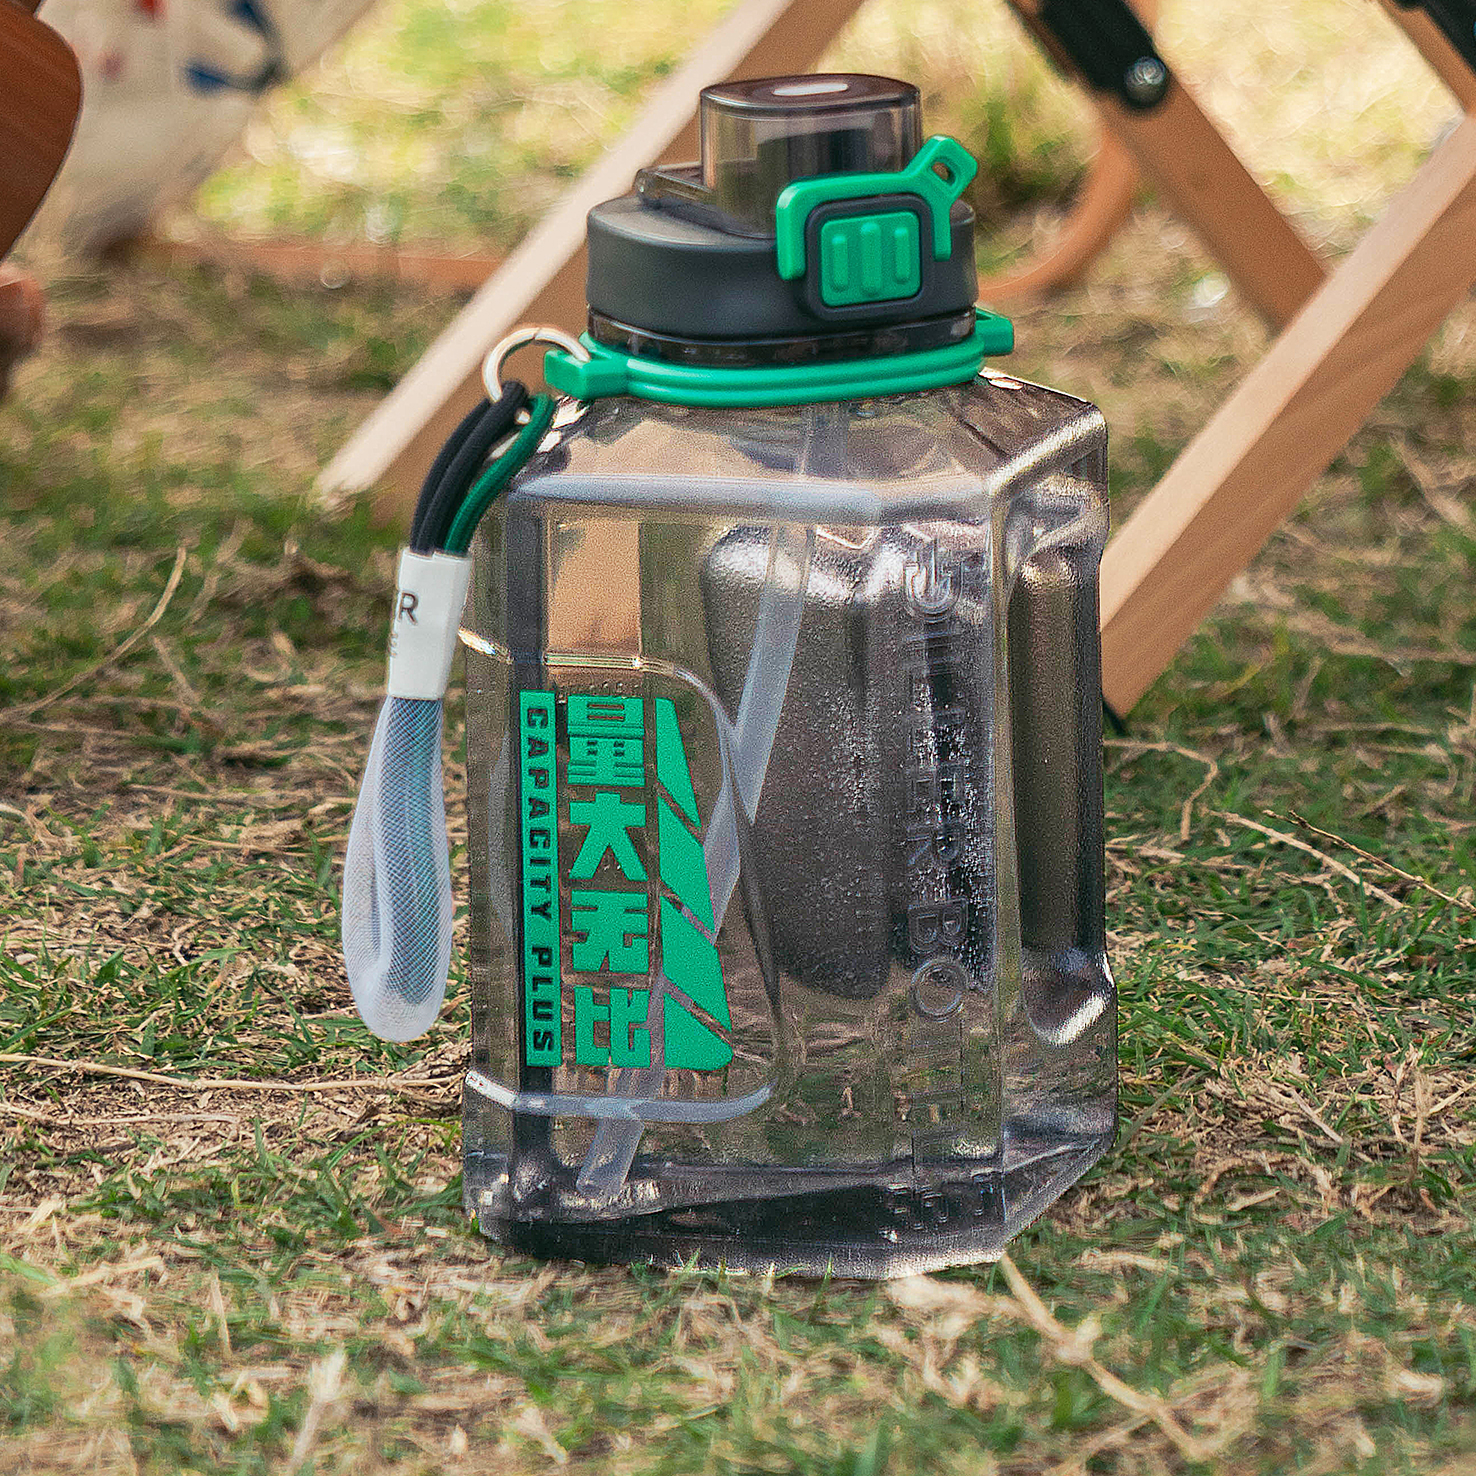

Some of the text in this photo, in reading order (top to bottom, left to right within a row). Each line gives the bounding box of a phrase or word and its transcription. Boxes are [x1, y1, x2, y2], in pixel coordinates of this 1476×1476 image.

[526, 707, 554, 1053] CAPACITY PLUS
[567, 695, 651, 1069] 量大无比
